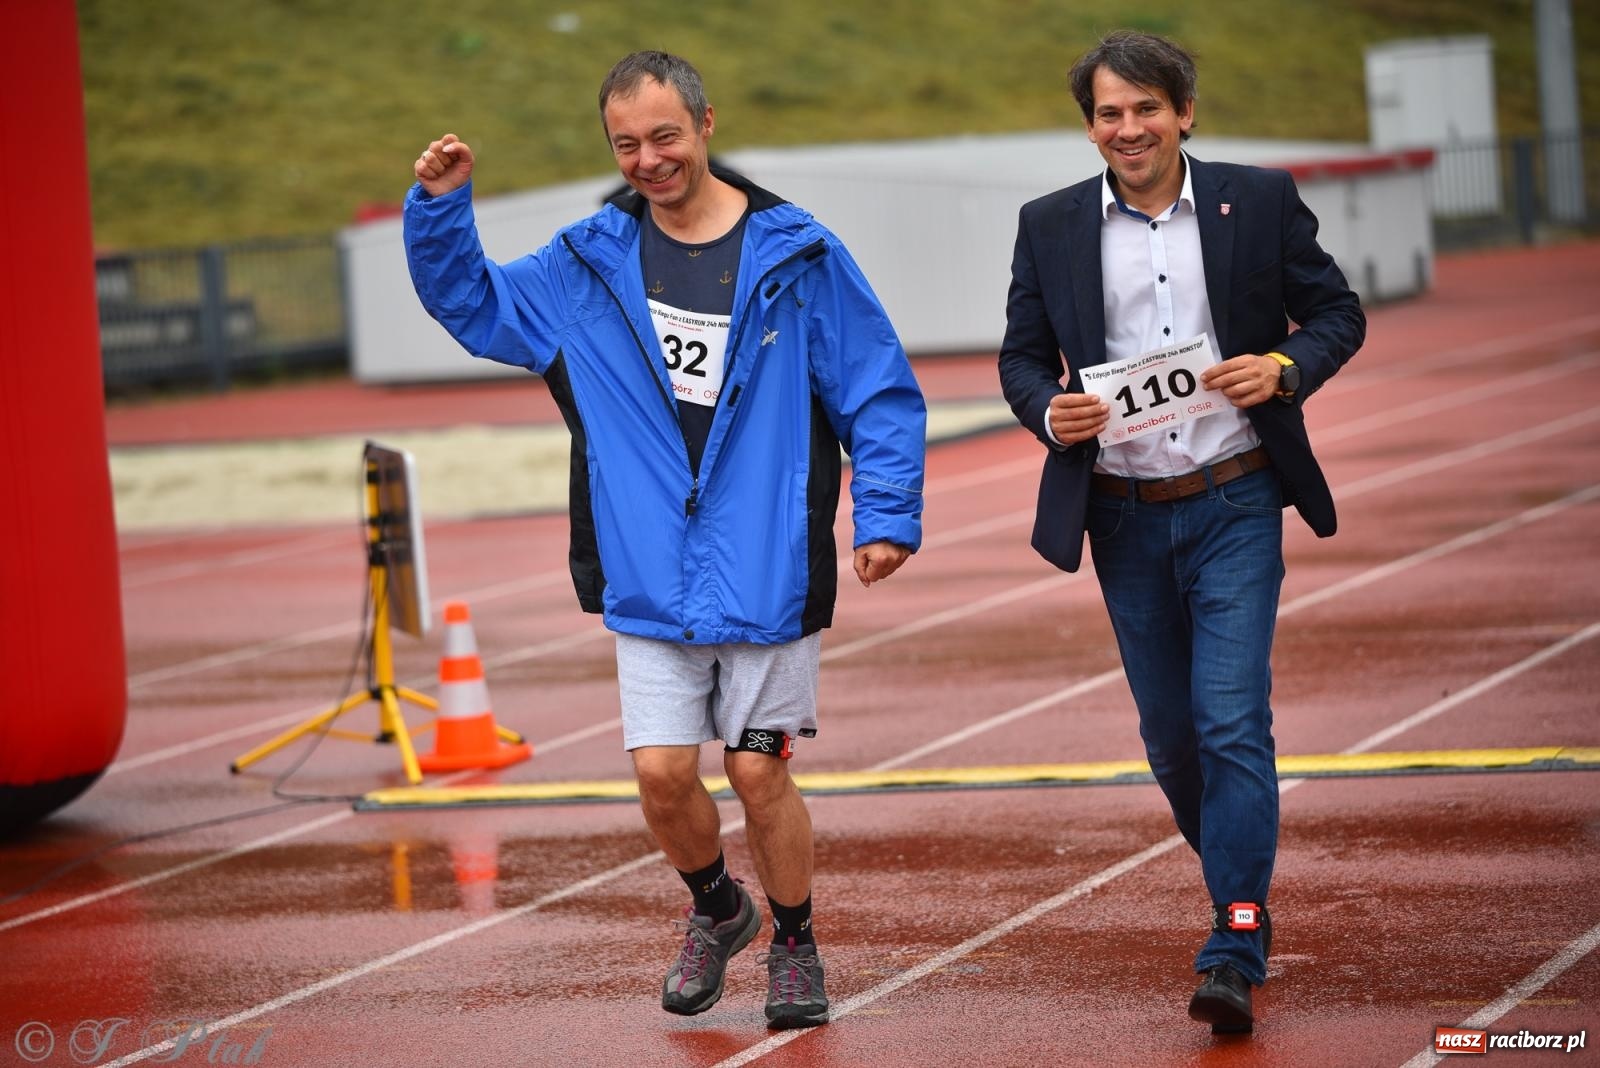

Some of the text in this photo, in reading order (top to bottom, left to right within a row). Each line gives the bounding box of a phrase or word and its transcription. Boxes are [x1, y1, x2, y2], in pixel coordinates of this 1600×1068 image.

[669, 313, 679, 321] Fun
[682, 316, 706, 327] EASYRUN
[706, 320, 717, 328] 24h
[663, 334, 708, 378] 32
[1092, 370, 1111, 379] Edycja
[1110, 366, 1127, 376] Biegu
[1127, 363, 1138, 371] Fun
[1141, 352, 1167, 365] EASYRUN
[1167, 350, 1179, 358] 24h
[1115, 368, 1197, 419] 110
[1127, 412, 1177, 434] Racibórz
